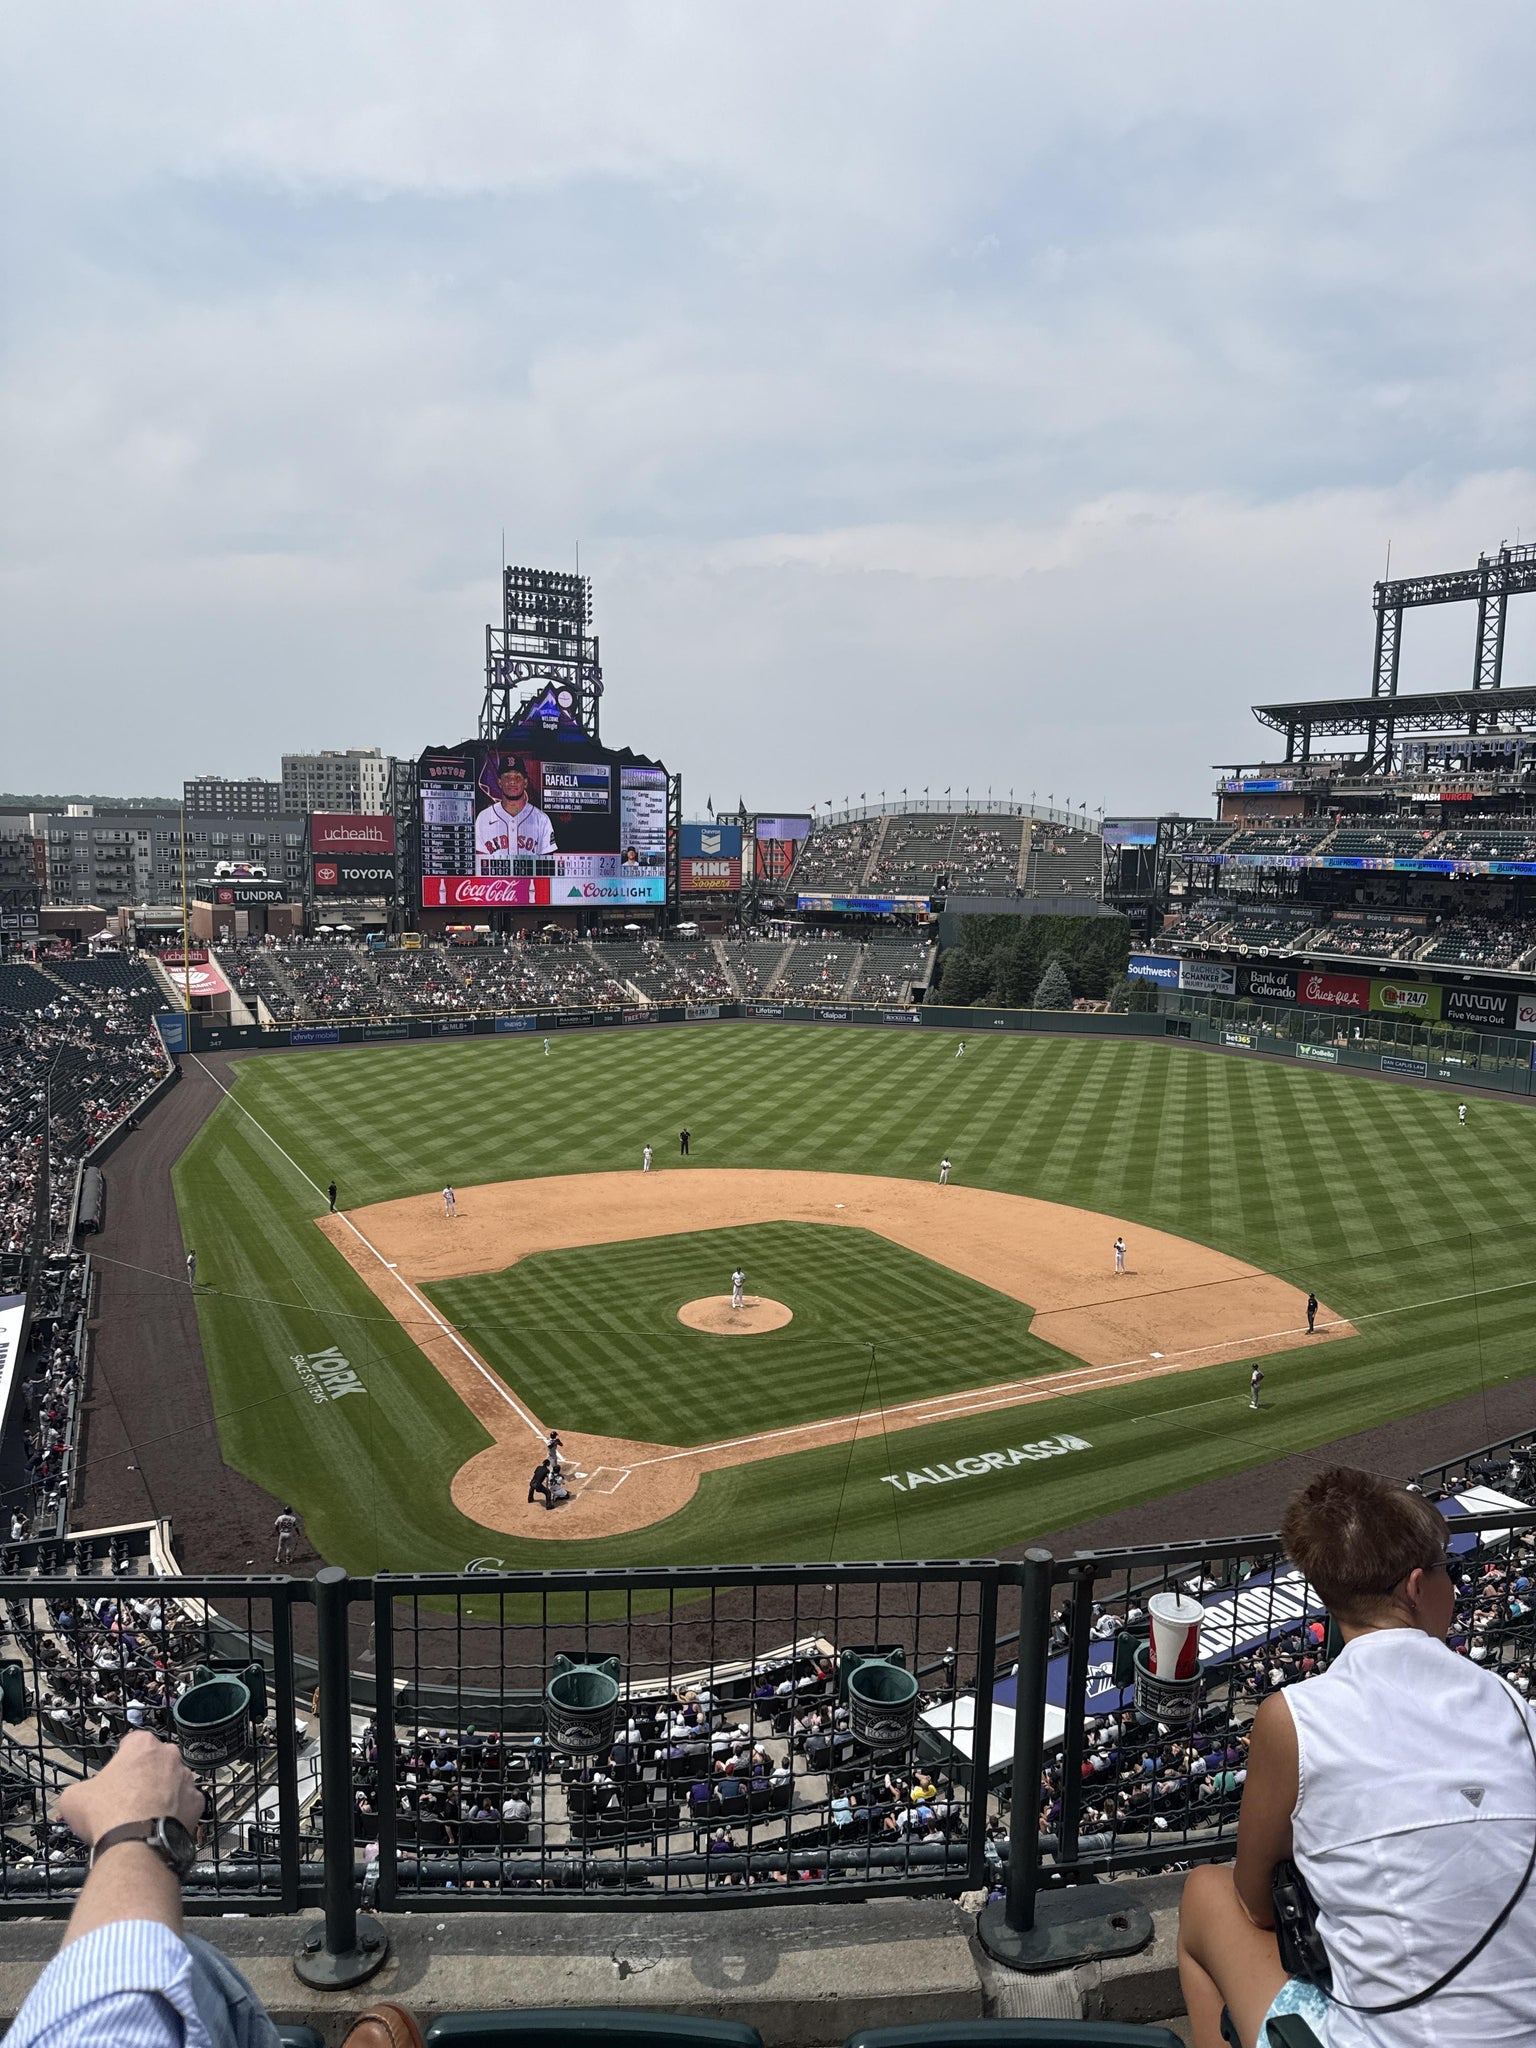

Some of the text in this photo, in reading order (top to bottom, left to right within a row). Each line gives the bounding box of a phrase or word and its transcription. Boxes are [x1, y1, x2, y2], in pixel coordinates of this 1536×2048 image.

[1392, 739, 1526, 760] THE ROOFTOP
[429, 766, 466, 778] BOSTON
[545, 774, 579, 787] RAFAELA
[1411, 793, 1473, 801] SMASHBURGER
[324, 825, 383, 841] uchealth
[342, 869, 394, 880] TOYOTA
[691, 862, 731, 876] KING
[692, 876, 731, 889] Soopers
[234, 890, 283, 901] TUNDRA
[455, 879, 518, 903] Coca-Cola
[583, 882, 653, 899] Coors LIGHT
[1127, 963, 1172, 978] Southwest
[1190, 964, 1220, 974] BACHUS
[1181, 971, 1219, 983] SCHANKER
[1250, 971, 1288, 984] Bank of
[1184, 980, 1229, 991] INJURY LAWYERS
[1250, 982, 1296, 998] Colorado
[1406, 992, 1428, 1004] 24/7
[755, 1007, 782, 1015] Lifetime
[821, 1010, 847, 1020] dialpad
[1448, 1010, 1505, 1025] Five Years Out
[293, 1033, 315, 1041] xfinity
[1225, 1033, 1251, 1044] bet365
[1311, 1049, 1335, 1058] DaBella
[1395, 1060, 1412, 1069] CAPLIS
[307, 1345, 368, 1400] YORK
[289, 1354, 329, 1404] SPACE SYSTEMS
[879, 1440, 1068, 1492] TALLGRASS
[561, 1735, 600, 1746] ROCKIES
